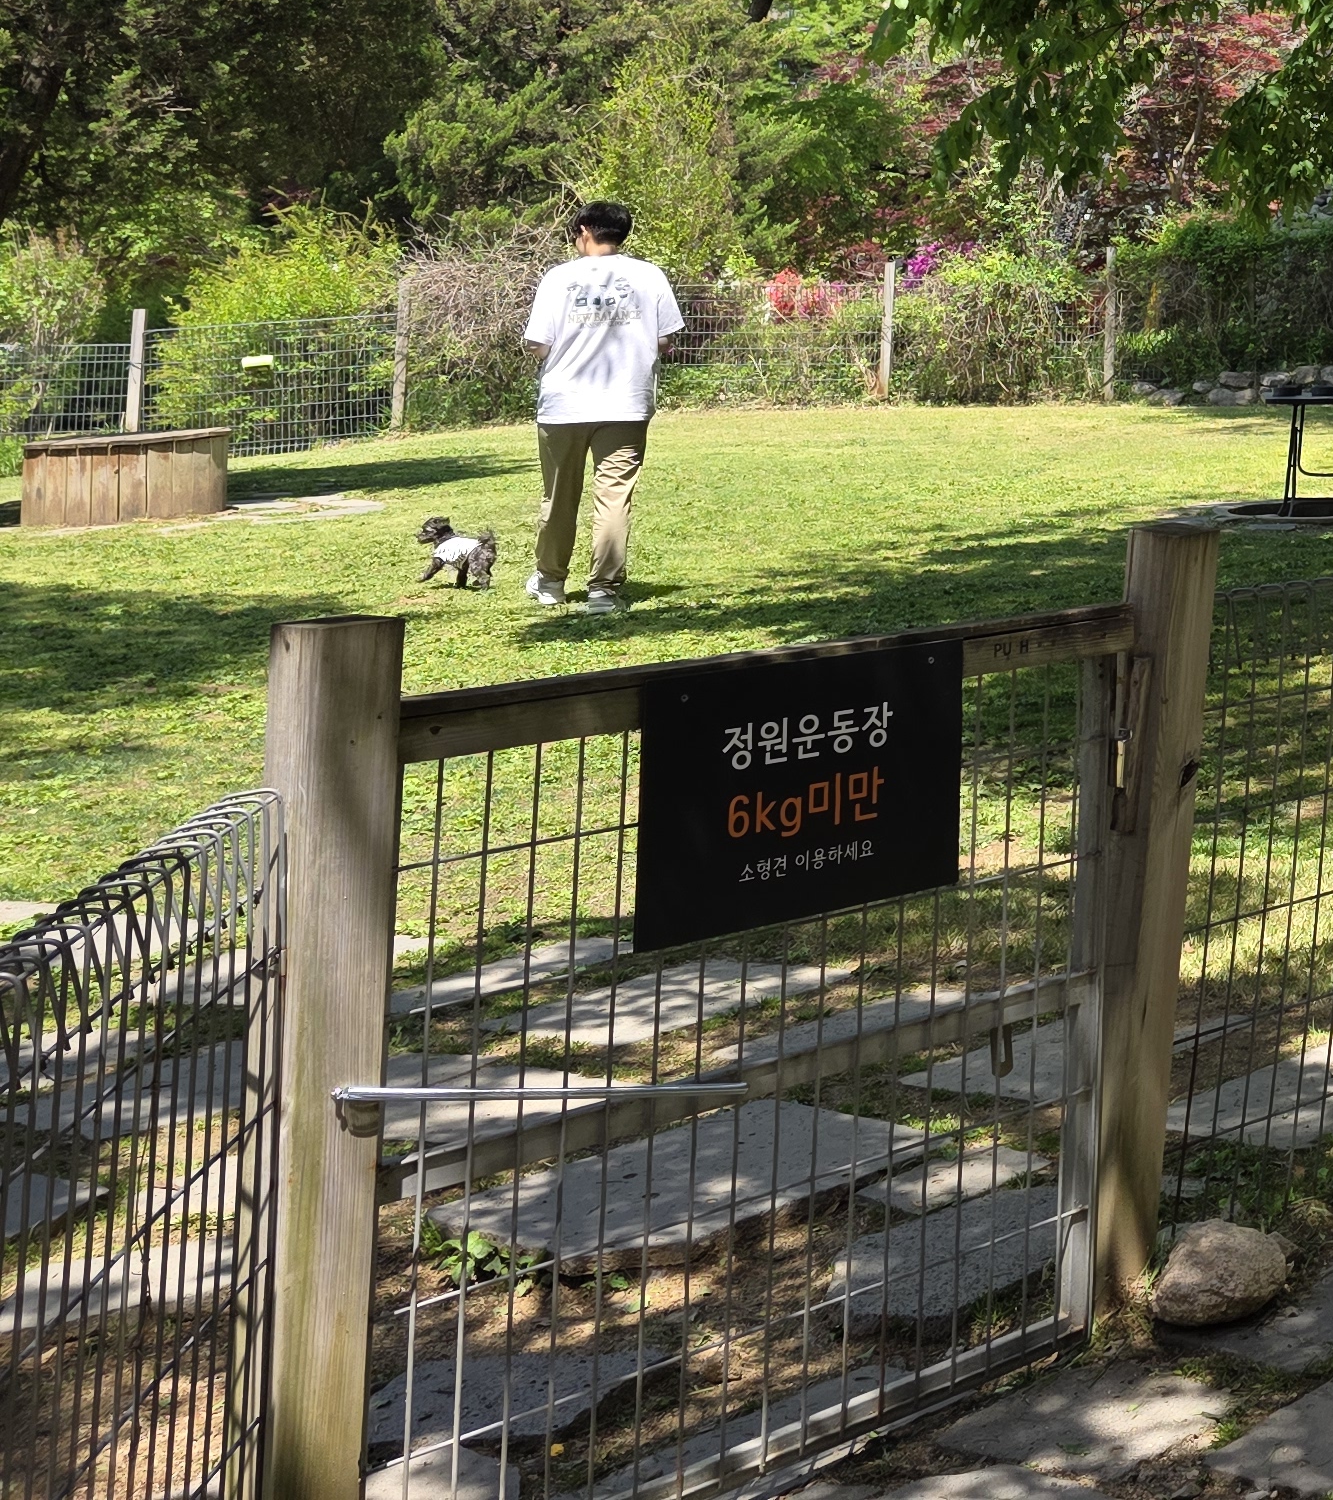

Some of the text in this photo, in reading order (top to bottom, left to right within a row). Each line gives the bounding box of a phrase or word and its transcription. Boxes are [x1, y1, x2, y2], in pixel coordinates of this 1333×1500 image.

[567, 310, 642, 323] NEW BALANCE
[721, 701, 894, 771] 정원운동장
[727, 766, 885, 839] 6kg미만
[738, 839, 875, 883] 소형견 이용하세요
